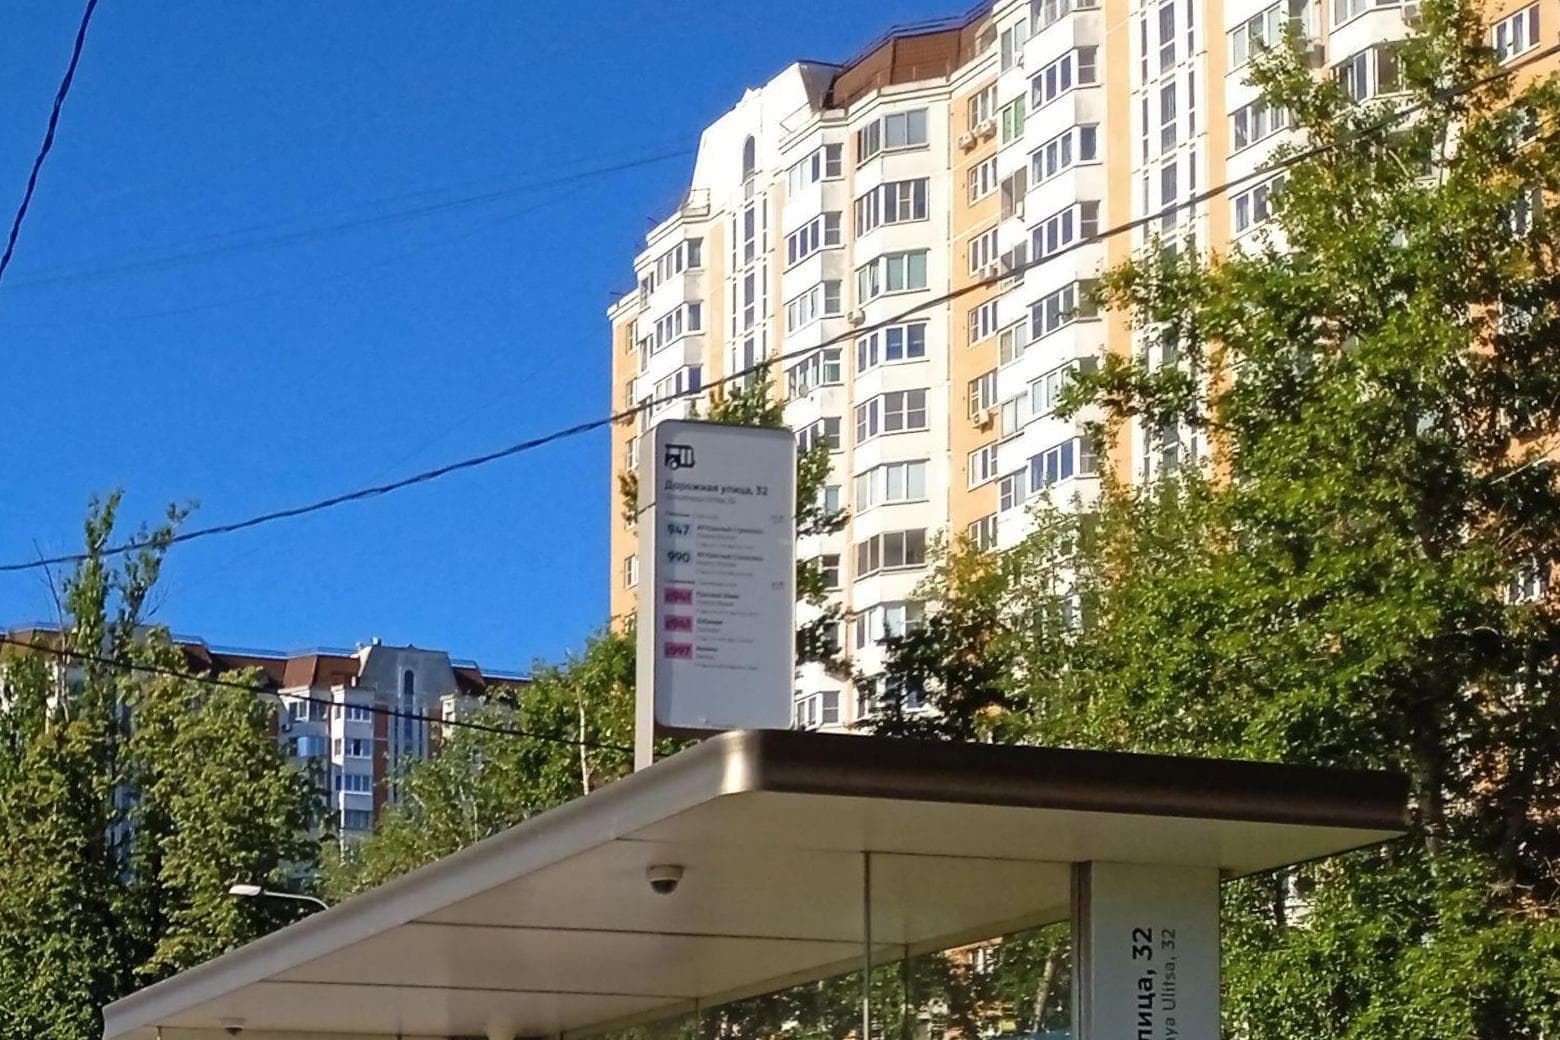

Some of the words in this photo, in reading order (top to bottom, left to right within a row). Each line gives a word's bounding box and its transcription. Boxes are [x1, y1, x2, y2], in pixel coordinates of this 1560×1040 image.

[755, 485, 768, 496] 32
[667, 551, 691, 563] 990
[1132, 926, 1153, 961] 32
[1161, 928, 1176, 948] 32
[1161, 956, 1177, 1012] Ulitsa,
